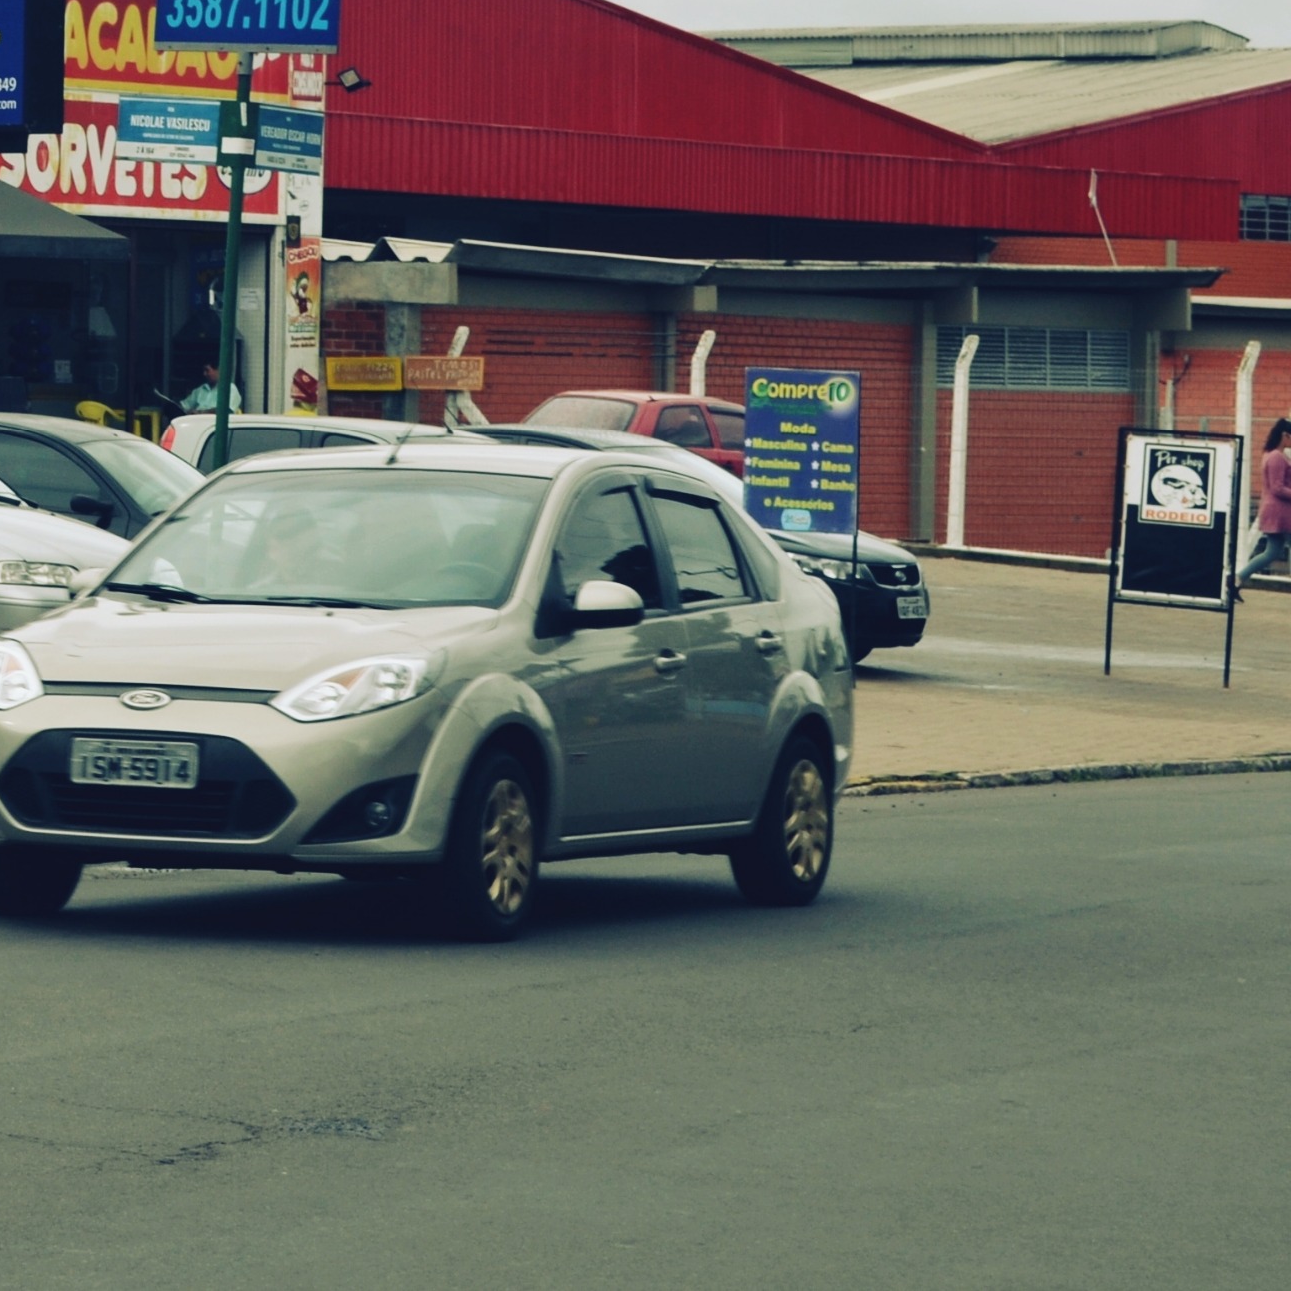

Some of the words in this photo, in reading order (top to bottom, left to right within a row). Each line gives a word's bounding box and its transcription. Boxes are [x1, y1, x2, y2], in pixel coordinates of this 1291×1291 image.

[130, 114, 165, 128] NICOLAE
[167, 117, 211, 132] VASILESCU
[288, 245, 319, 261] CHEGOU
[752, 378, 851, 403] Compre10
[780, 422, 817, 435] Moda
[753, 438, 807, 452] Masculina
[821, 442, 854, 455] Cama
[752, 457, 800, 471] Feminina
[821, 461, 851, 473] Mesa
[1181, 454, 1205, 472] shop
[751, 475, 790, 488] Infantil
[820, 479, 855, 492] Banho
[764, 497, 772, 508] e
[774, 497, 835, 511] Acessórios
[1146, 509, 1208, 523] RODEIO
